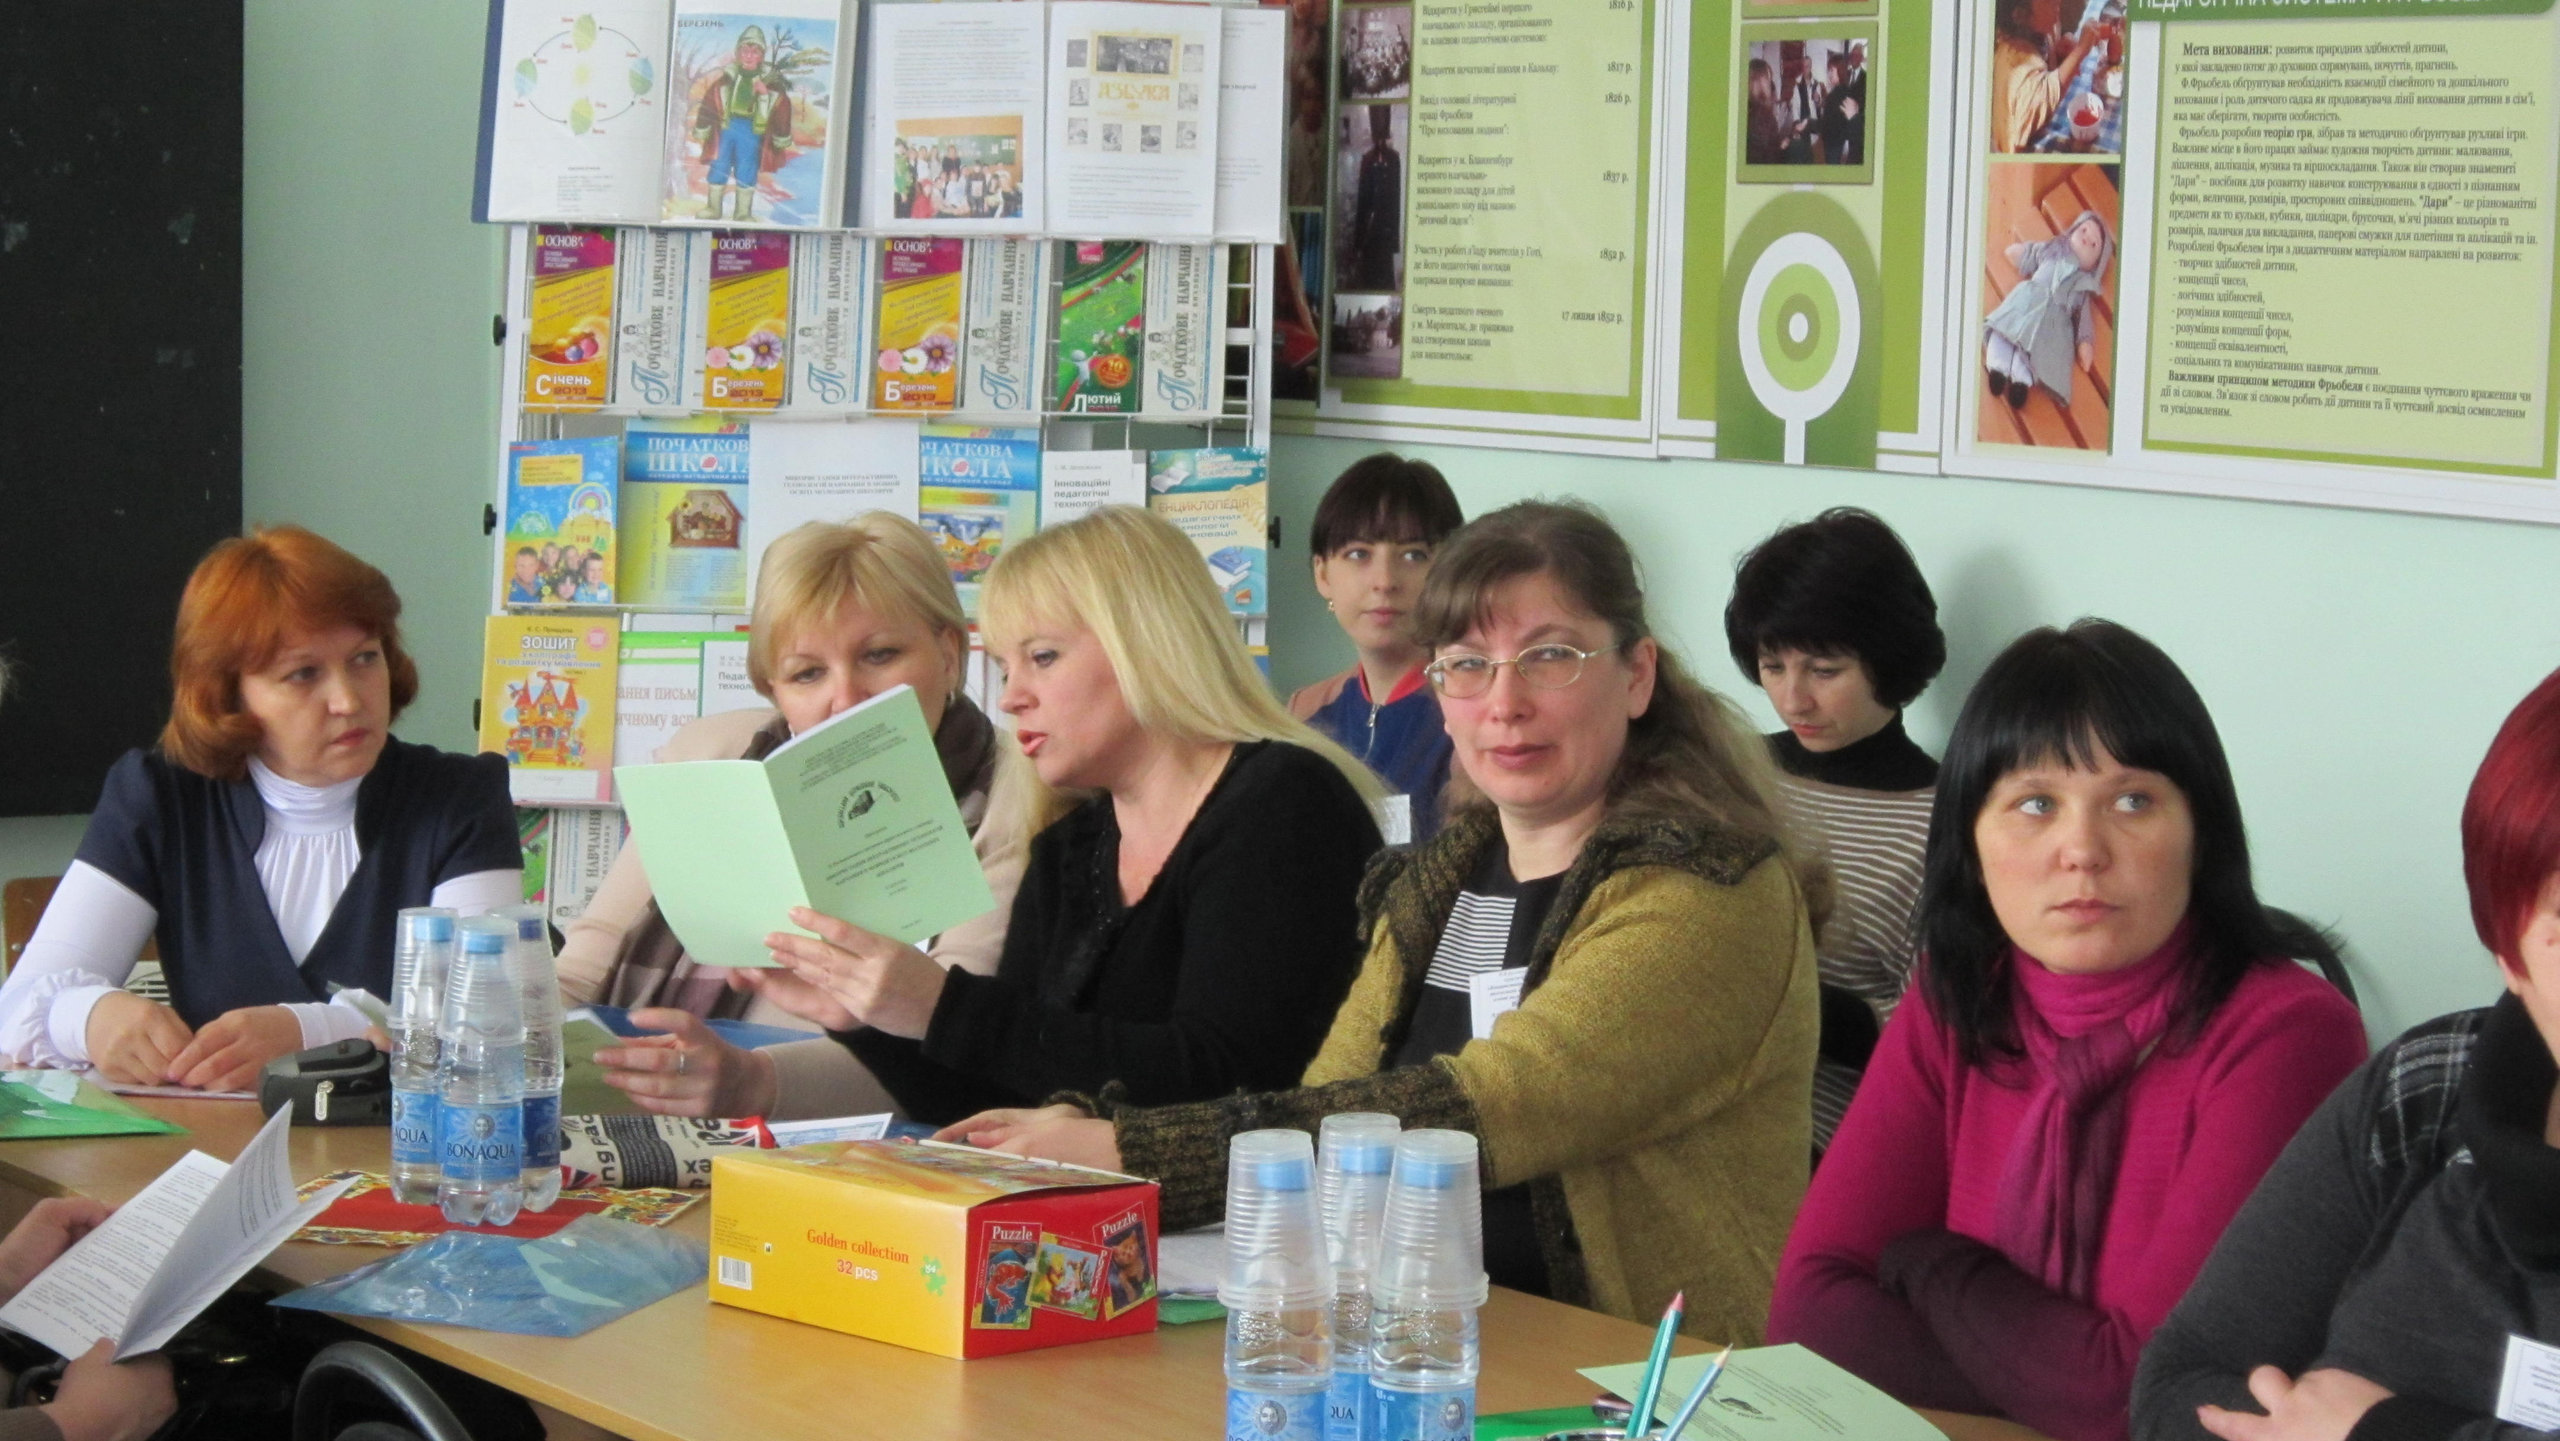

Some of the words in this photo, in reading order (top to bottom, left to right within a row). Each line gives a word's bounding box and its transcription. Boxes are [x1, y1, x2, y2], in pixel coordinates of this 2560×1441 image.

[1608, 61, 1624, 73] 1817
[1605, 92, 1623, 103] 1826
[1603, 170, 1620, 183] 1837
[1600, 248, 1617, 261] 1852
[1562, 311, 1569, 321] 17
[1598, 311, 1615, 323] 1852
[536, 374, 591, 395] Січень
[712, 376, 765, 398] Березень
[885, 380, 938, 402] Березень
[1071, 392, 1122, 412] Лютий
[648, 438, 749, 452] ПОЧАТКОВ
[920, 441, 1014, 459] ЧАТКОВА
[521, 635, 577, 650] ЗОШИТ
[447, 1143, 516, 1160] BONAQUA
[992, 1225, 1033, 1241] Puzzle
[1102, 1211, 1138, 1238] Puzzle
[806, 1229, 848, 1250] Golden
[851, 1241, 910, 1264] collection
[836, 1259, 853, 1275] 32
[855, 1266, 879, 1281] pcs
